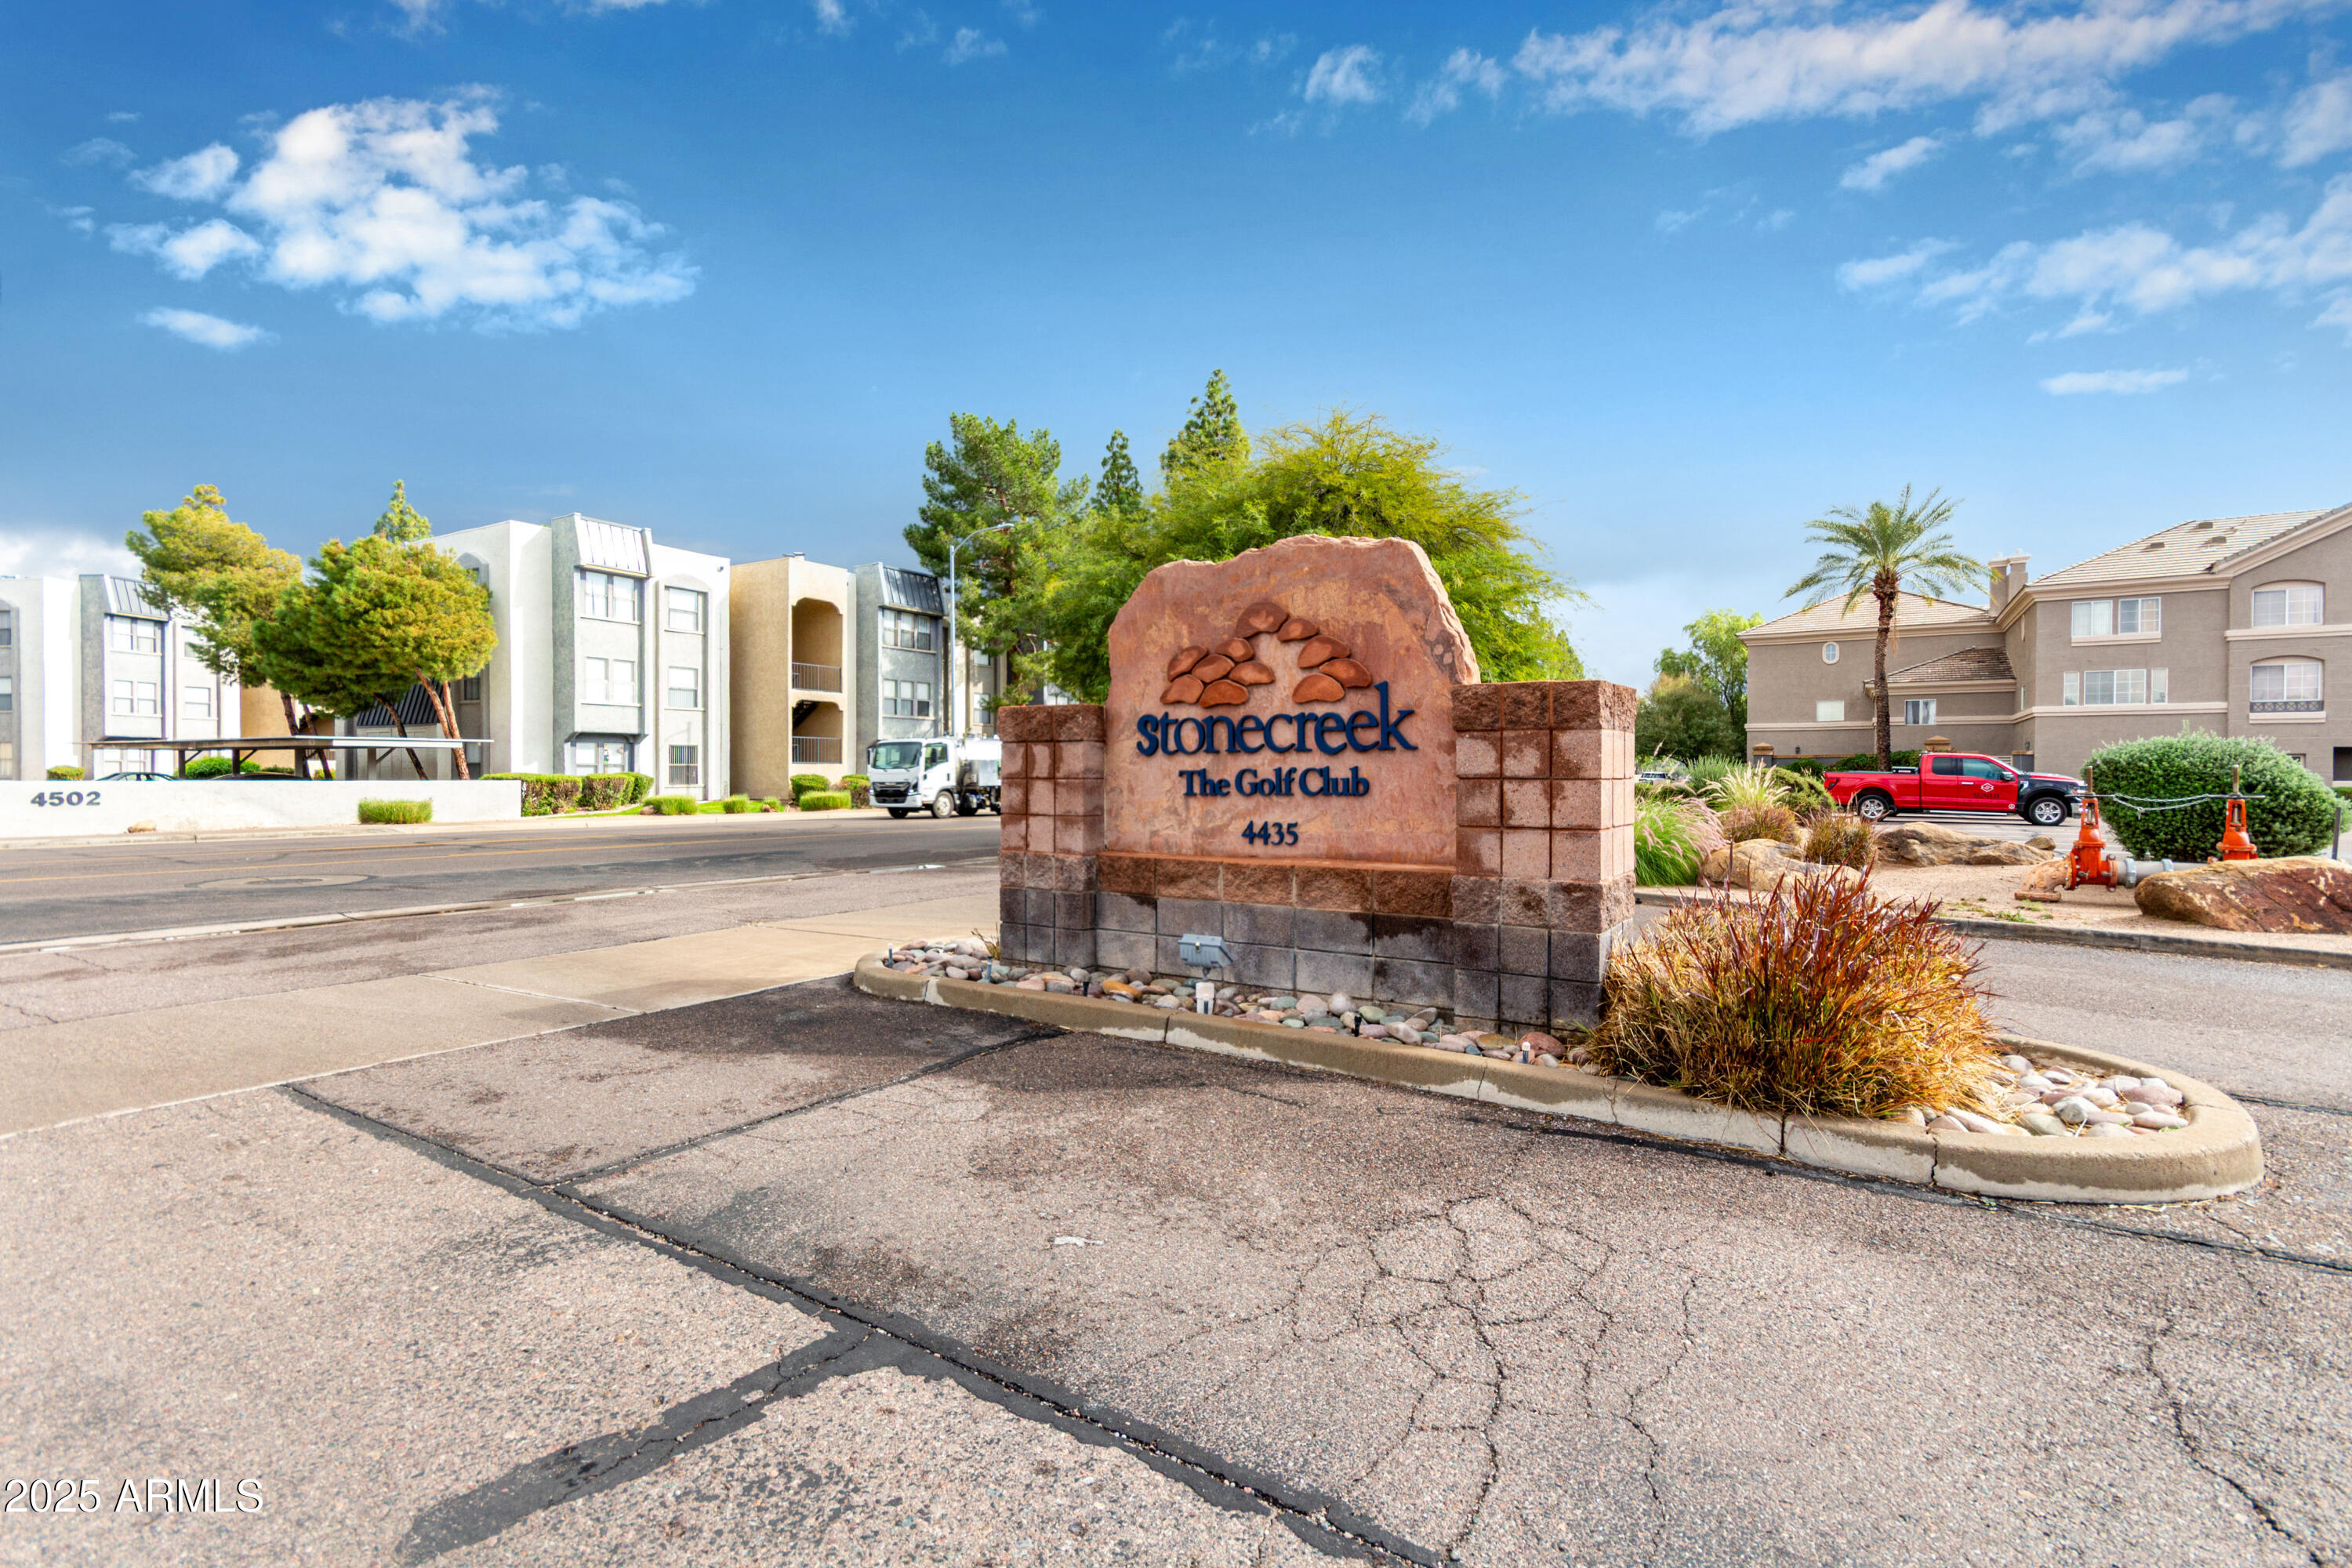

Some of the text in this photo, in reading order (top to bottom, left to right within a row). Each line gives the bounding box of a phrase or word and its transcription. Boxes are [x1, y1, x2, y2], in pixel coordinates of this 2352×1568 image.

[1136, 681, 1419, 757] stonecreek
[1178, 765, 1370, 797] The Golf Club
[31, 790, 101, 808] 4502
[1241, 820, 1299, 845] 4435
